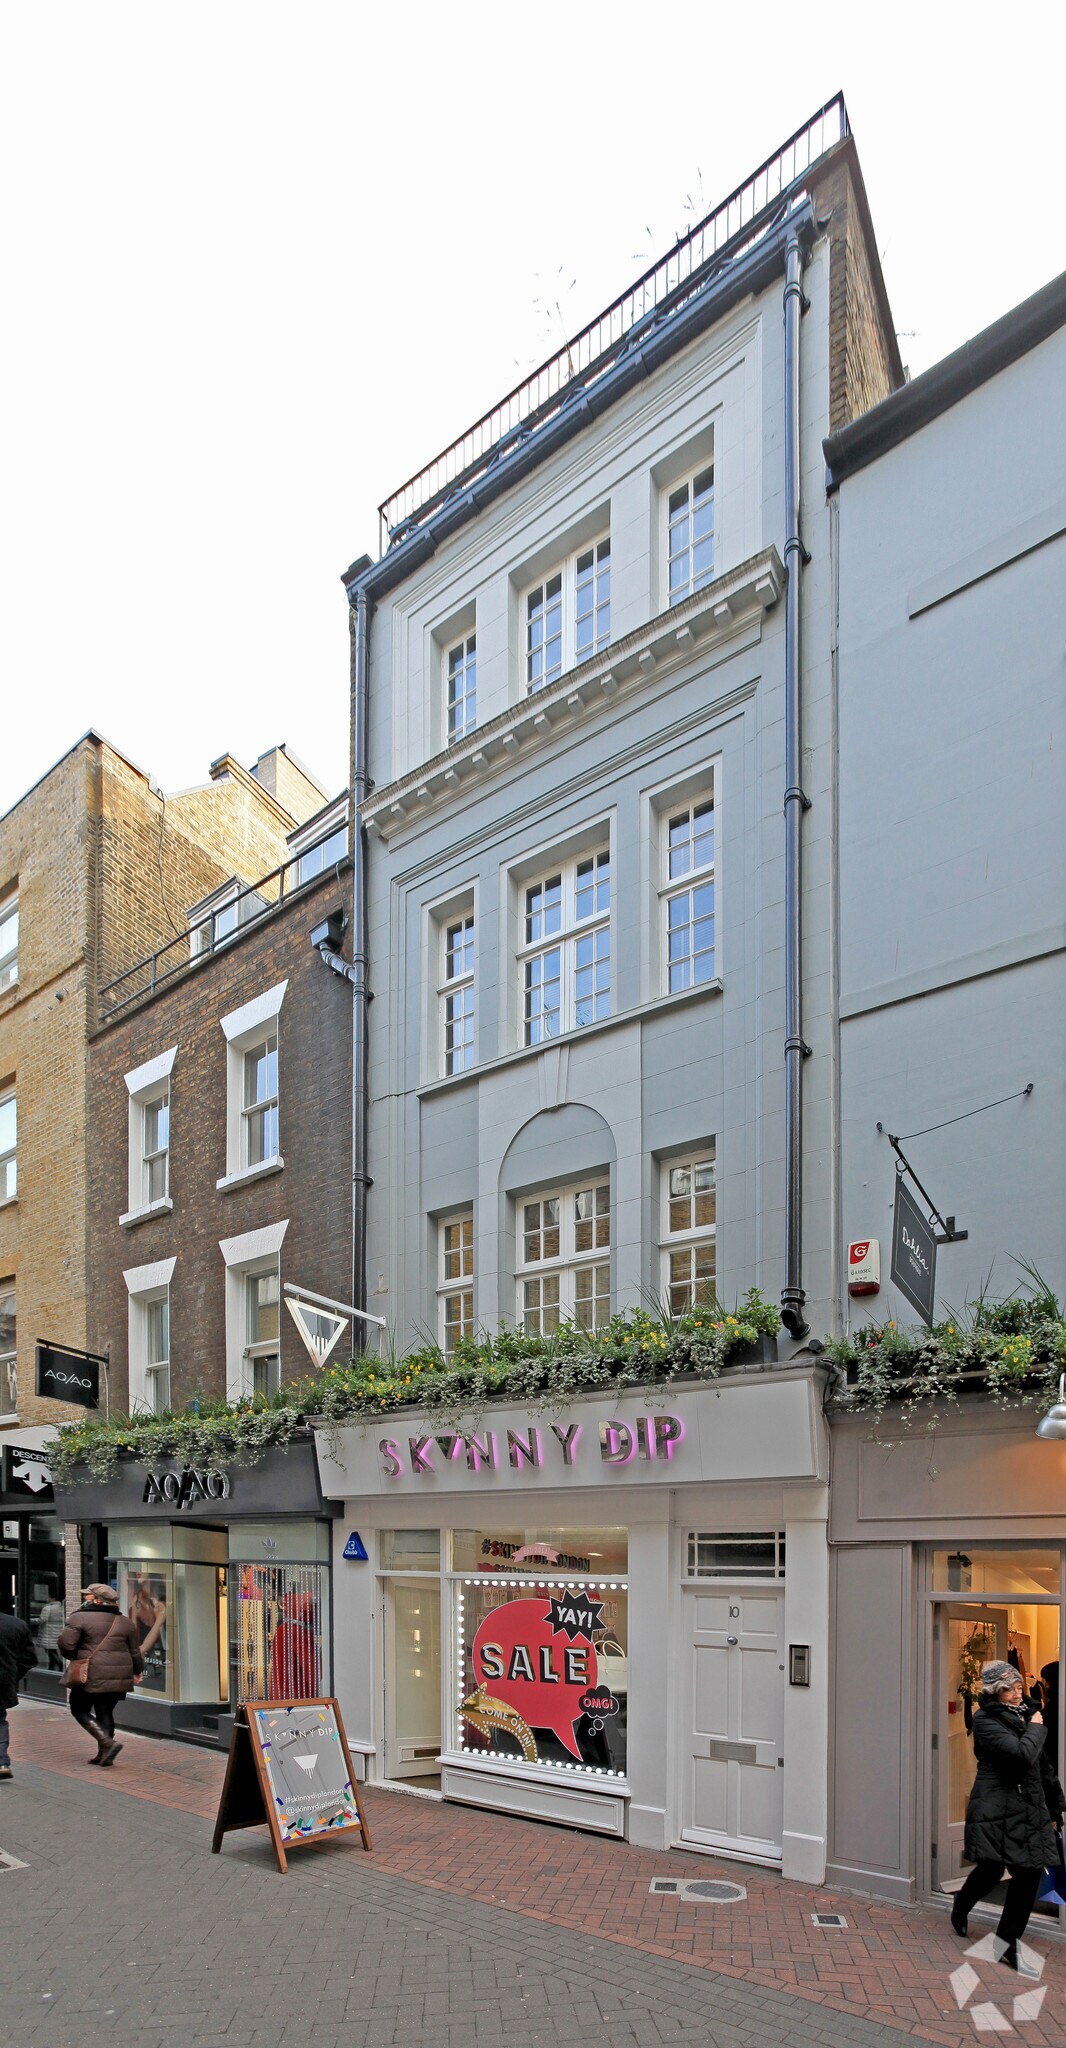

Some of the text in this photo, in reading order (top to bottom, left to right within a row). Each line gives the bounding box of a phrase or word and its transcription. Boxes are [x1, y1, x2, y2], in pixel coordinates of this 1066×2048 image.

[44, 1369, 92, 1388] AQ/AQ
[600, 1415, 682, 1463] DIP
[557, 1605, 593, 1628] YAY!
[729, 1606, 740, 1618] 10
[480, 1642, 590, 1685] SALE
[583, 1697, 614, 1710] OMG!
[318, 1727, 334, 1737] DIP
[479, 1703, 533, 1748] COME ON IN!
[285, 1788, 344, 1804] #skinnydiplondon
[286, 1798, 348, 1816] @skinnydiplondon
